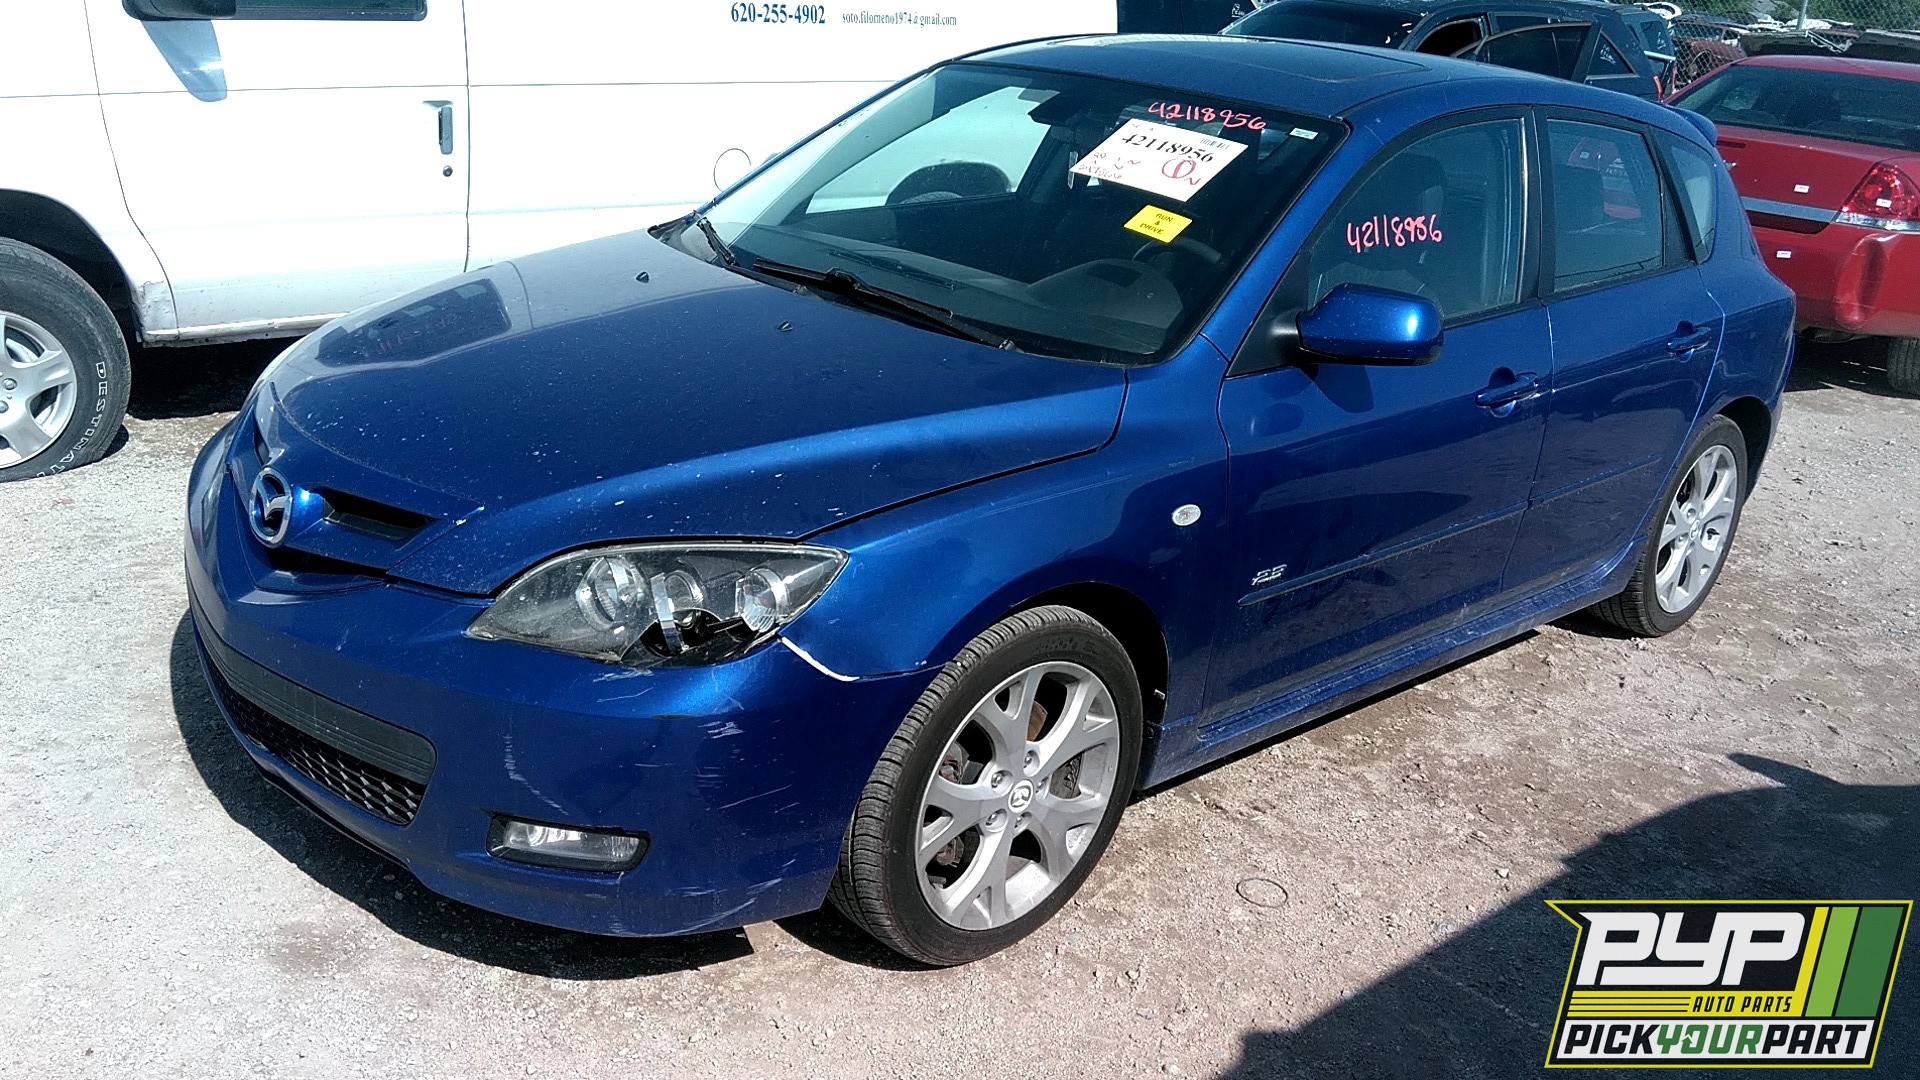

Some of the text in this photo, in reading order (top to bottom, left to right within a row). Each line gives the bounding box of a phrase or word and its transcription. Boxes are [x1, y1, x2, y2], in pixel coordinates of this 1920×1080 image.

[731, 2, 826, 24] 620-255-4902
[842, 10, 957, 28] soto.filomeno1974@gmail.com
[1147, 101, 1267, 130] 42118956
[1122, 133, 1214, 163] 42118956
[1139, 222, 1165, 235] DRIVE
[1155, 213, 1174, 222] RUN
[1346, 213, 1443, 253] 42118956
